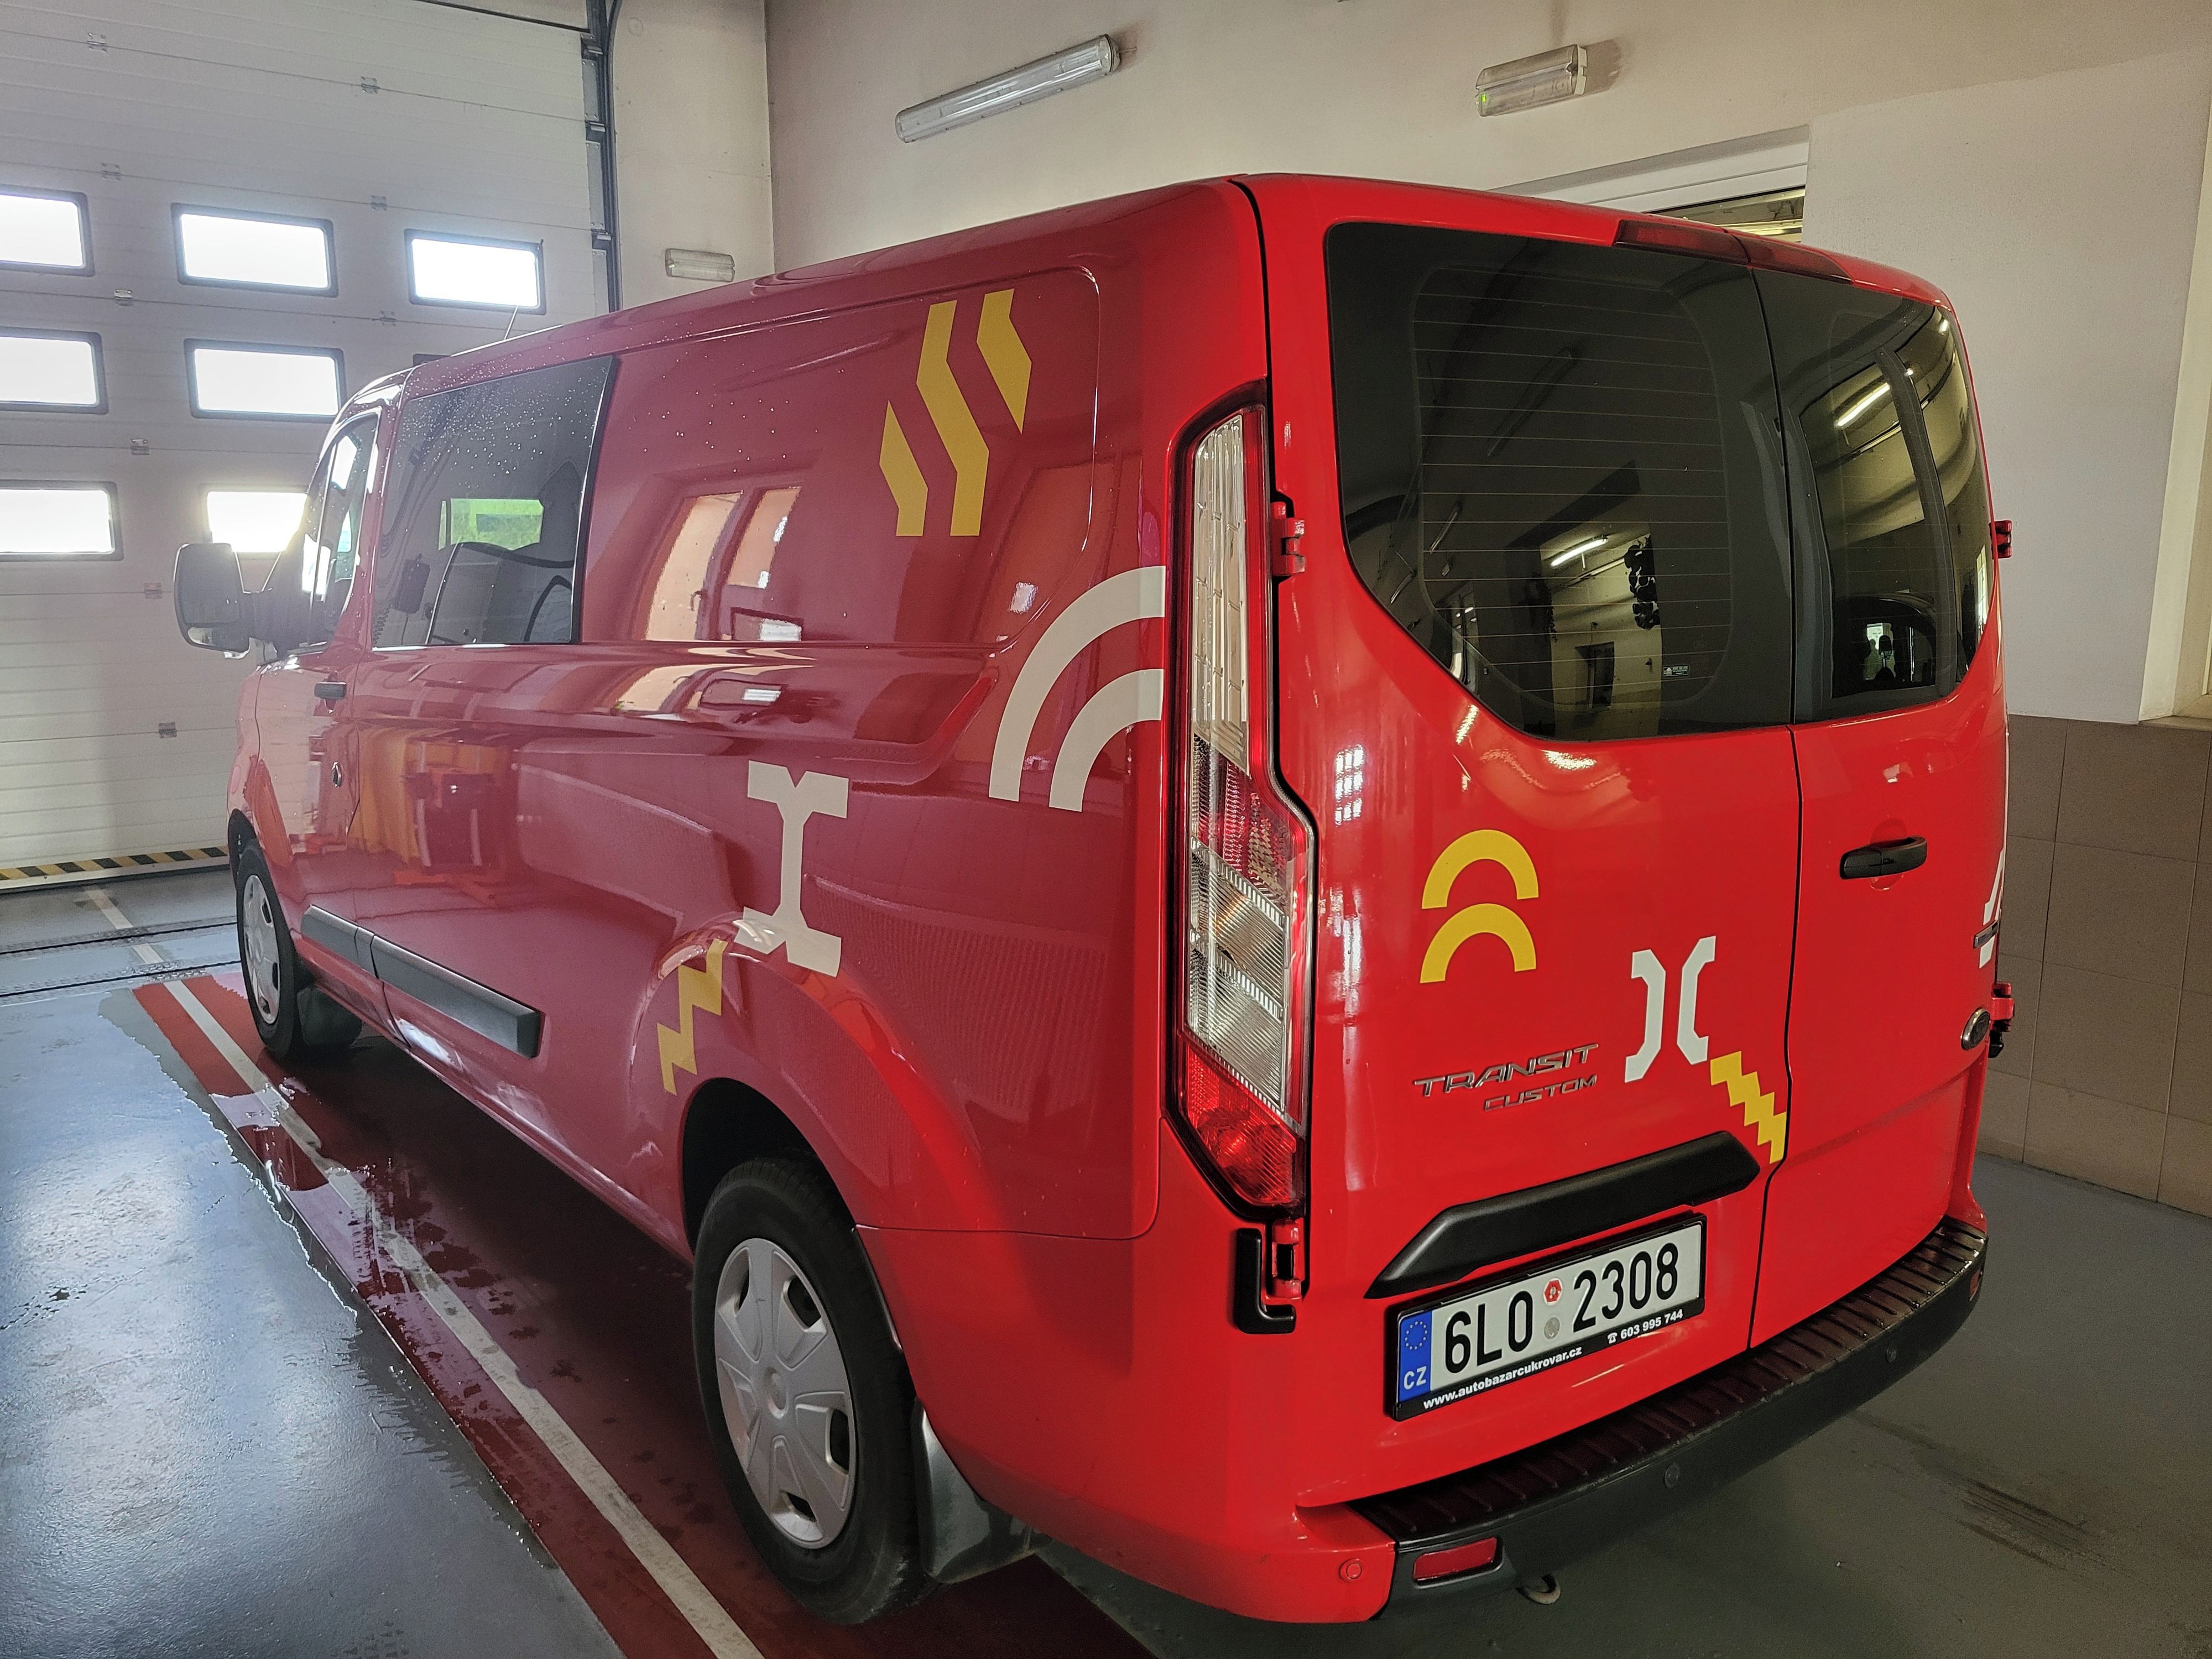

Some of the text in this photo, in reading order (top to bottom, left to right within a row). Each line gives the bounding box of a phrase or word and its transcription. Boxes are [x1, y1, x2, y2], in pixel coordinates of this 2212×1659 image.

[1414, 1044, 1599, 1097] TRANSIT
[1484, 1074, 1597, 1111] CUSTOM
[1573, 1242, 1678, 1333] 2308
[1403, 1365, 1427, 1390] CZ
[1423, 1309, 1683, 1409] www.autobazarcukrovar.cz 603 995 744
